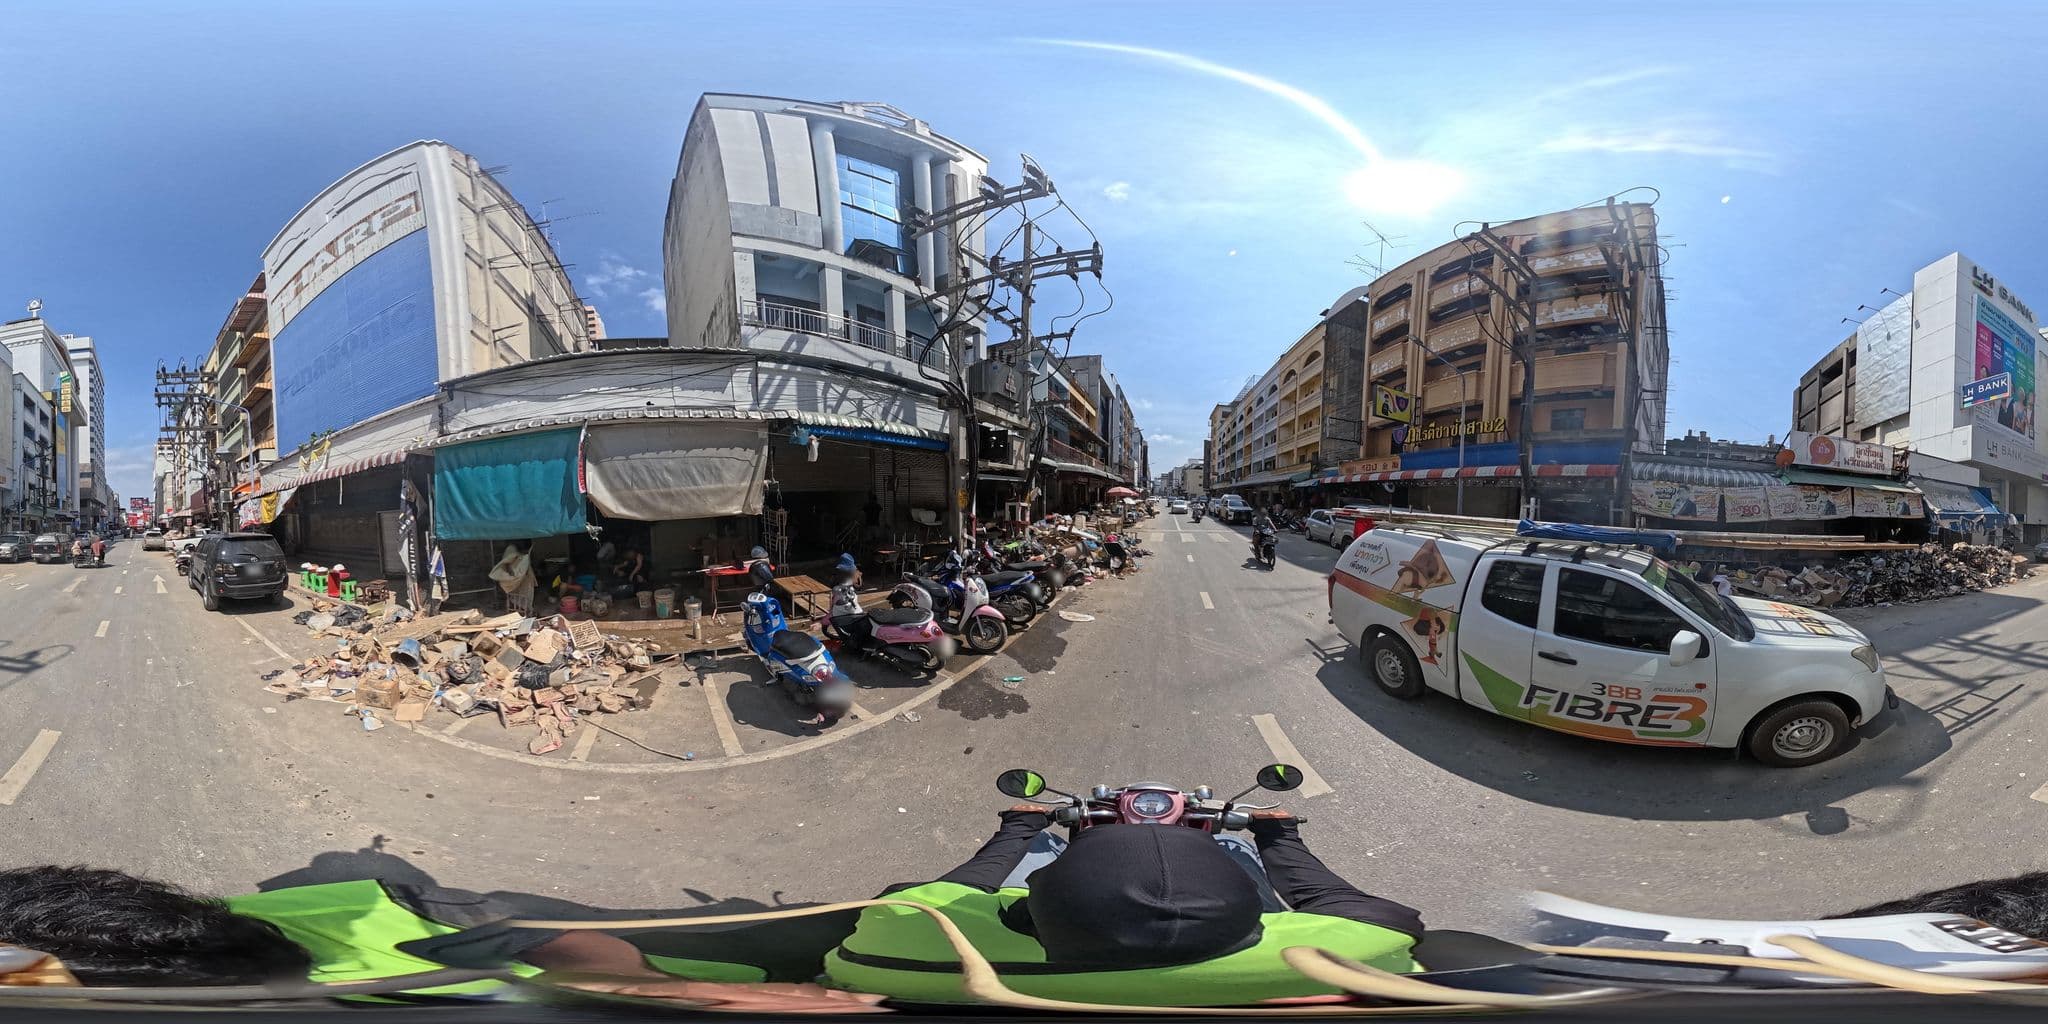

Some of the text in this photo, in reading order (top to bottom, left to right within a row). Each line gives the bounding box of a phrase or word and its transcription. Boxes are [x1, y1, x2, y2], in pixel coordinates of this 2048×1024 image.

[1973, 265, 1994, 289] LH
[1999, 285, 2034, 323] BANK
[1978, 378, 2008, 393] BANK
[1987, 440, 1998, 452] LH
[1592, 683, 1642, 700] 3BB
